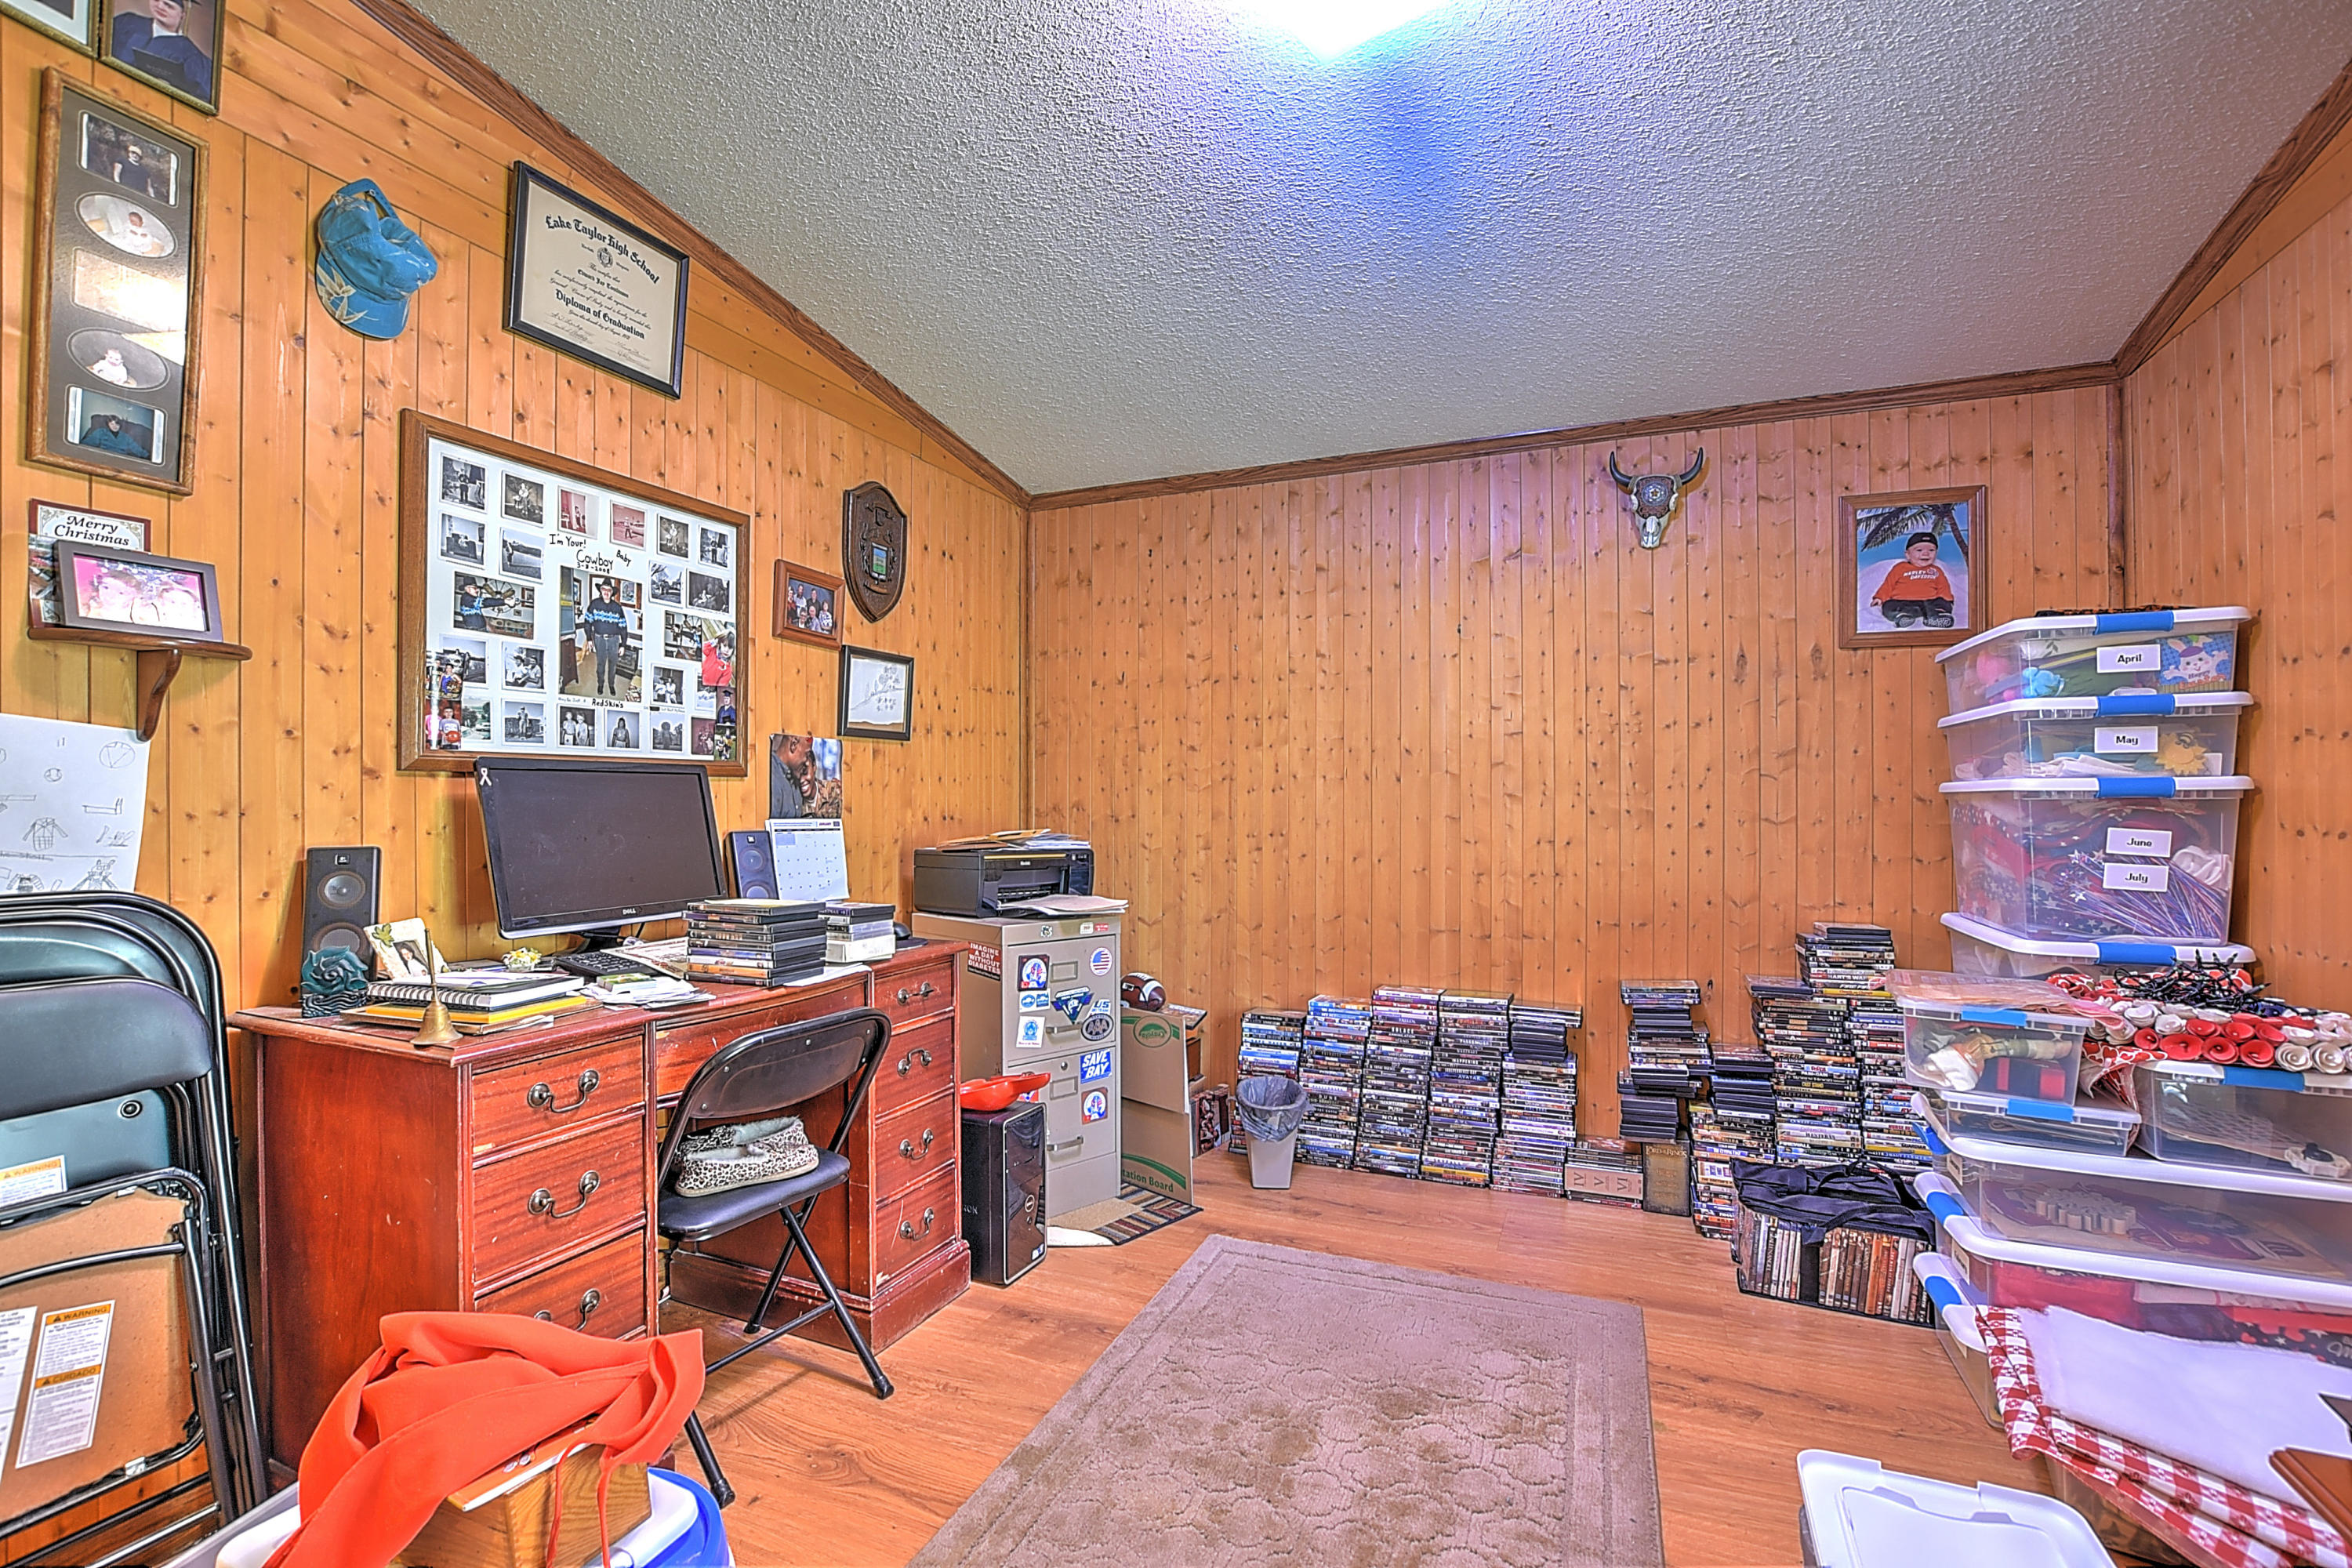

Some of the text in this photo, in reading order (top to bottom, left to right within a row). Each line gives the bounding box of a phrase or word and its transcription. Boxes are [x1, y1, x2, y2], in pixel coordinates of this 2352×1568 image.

[546, 214, 572, 229] Lake
[573, 219, 607, 242] Taylor
[607, 234, 629, 256] High
[630, 252, 659, 284] School
[556, 289, 591, 314] Diploma
[593, 310, 601, 318] of
[603, 313, 645, 339] Graduation
[67, 515, 118, 534] Merry
[54, 524, 129, 546] Christmas
[550, 534, 563, 545] I'm
[576, 550, 613, 570] Cowboy
[616, 550, 631, 567] Baby
[2117, 654, 2142, 664] April
[2188, 670, 2211, 680] Happy
[2116, 735, 2139, 746] May
[2126, 837, 2152, 847] June
[2125, 873, 2148, 884] July
[970, 942, 1000, 956] IMAGINE
[981, 952, 994, 960] DAY
[969, 953, 1000, 967] WITHOUT
[968, 960, 1000, 975] DIABETES
[1082, 1049, 1110, 1068] SAVE
[1085, 1062, 1109, 1079] BAY
[1149, 1176, 1174, 1192] Board
[1574, 1172, 1584, 1186] IV
[1594, 1177, 1604, 1187] V
[1617, 1178, 1628, 1192] VI
[64, 1306, 107, 1320] WARNING
[53, 1367, 96, 1383] CUIDADO
